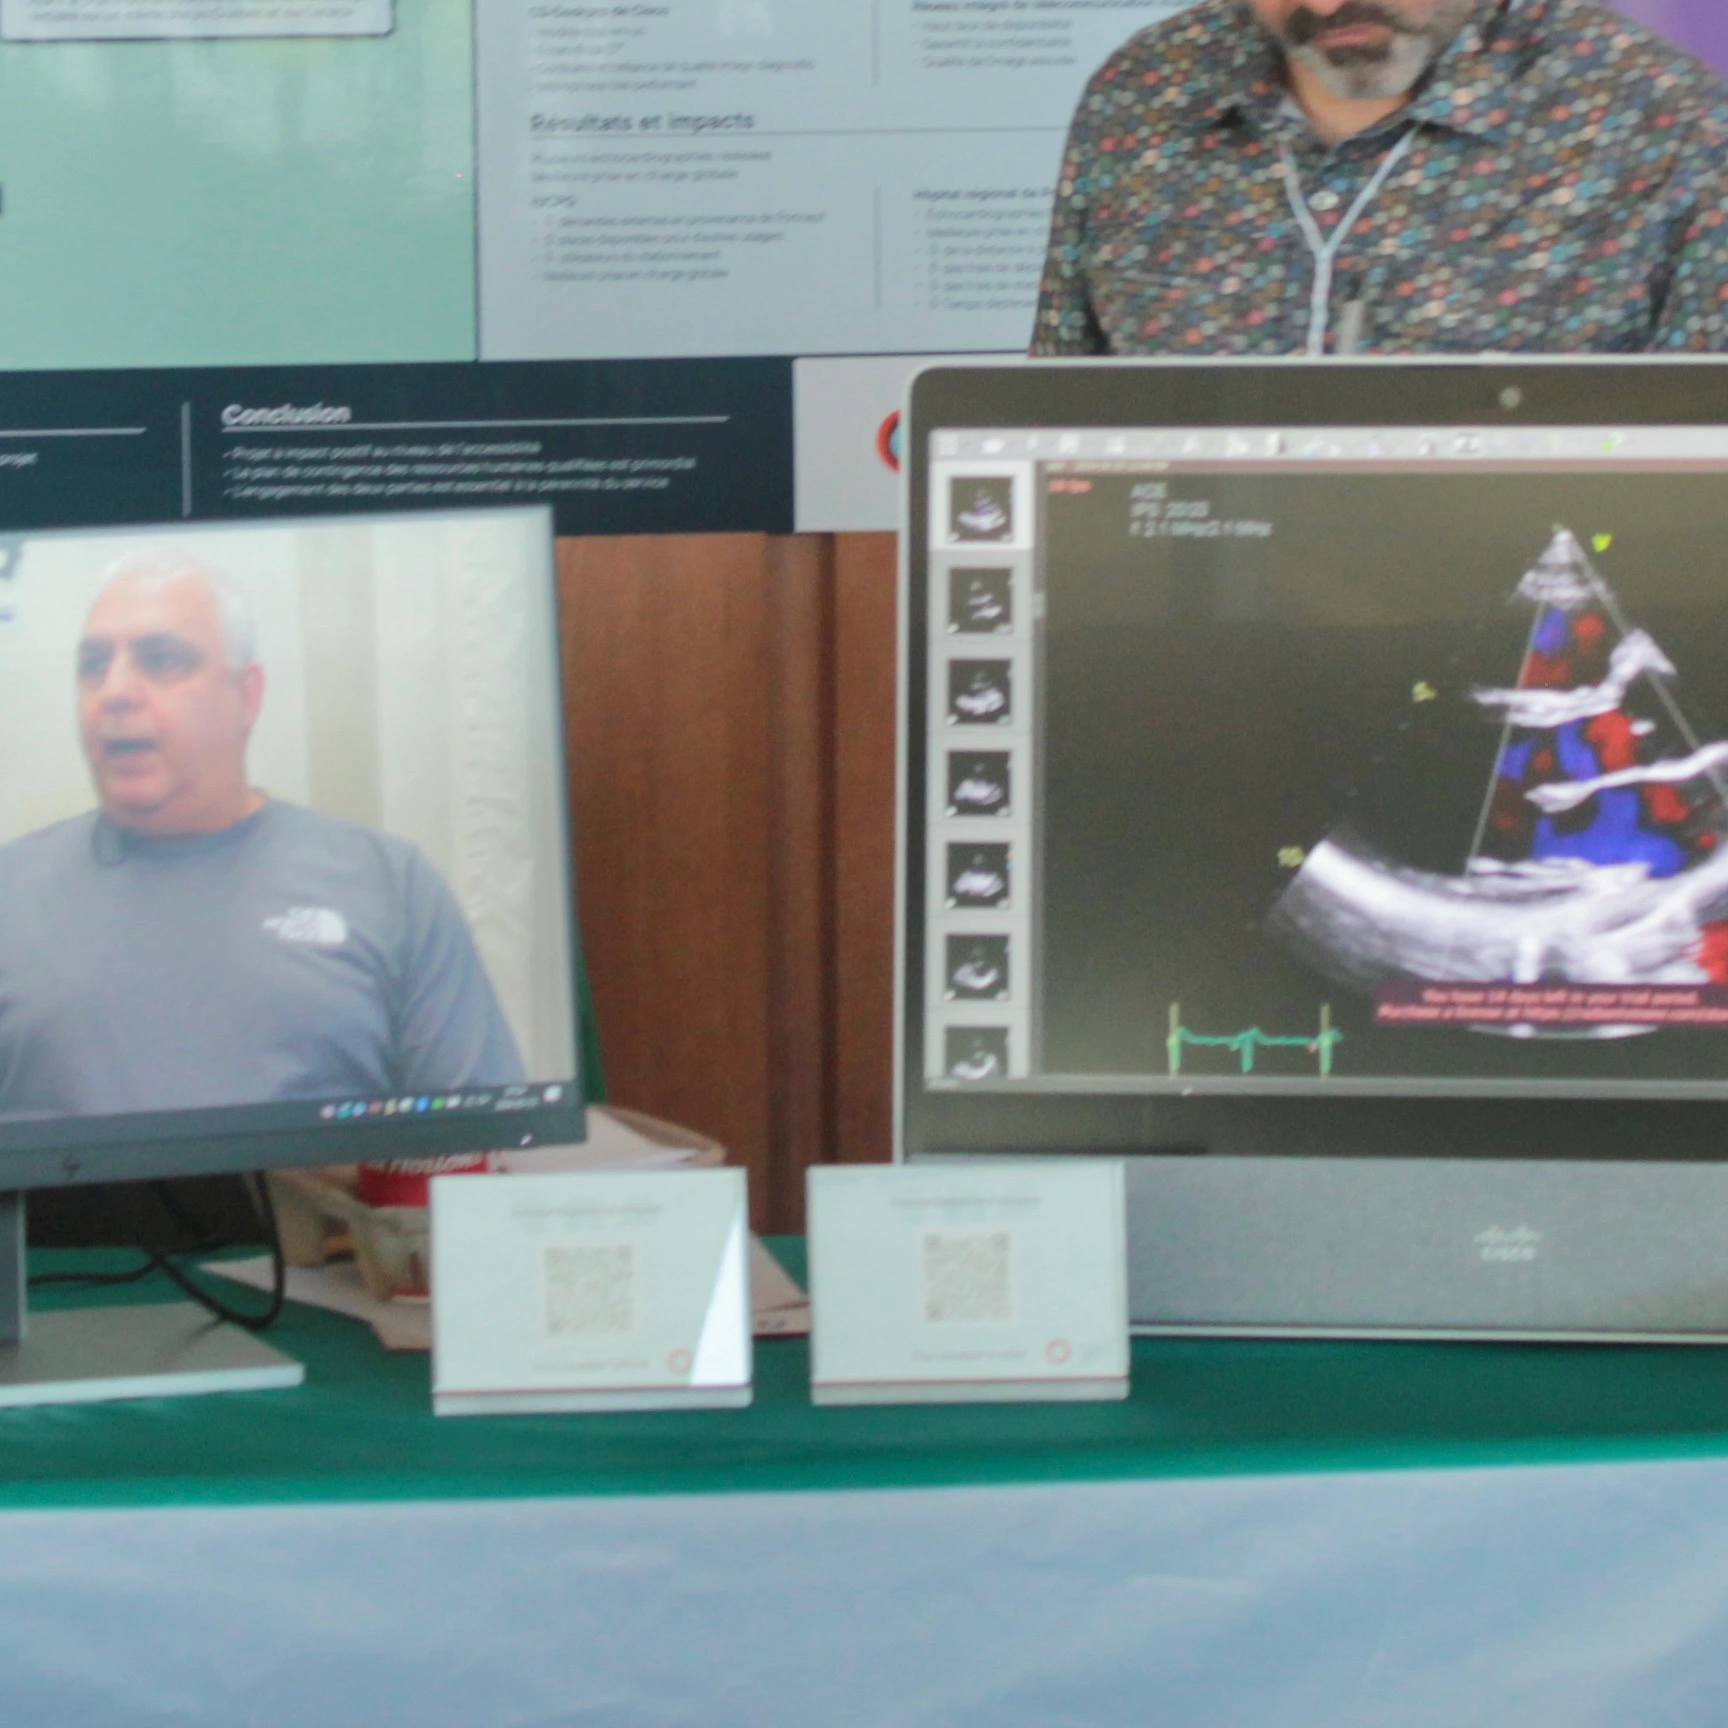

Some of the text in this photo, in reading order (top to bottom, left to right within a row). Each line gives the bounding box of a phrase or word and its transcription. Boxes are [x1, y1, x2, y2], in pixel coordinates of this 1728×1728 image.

[531, 112, 756, 134] Résultats et impacts
[221, 402, 352, 425] Conclusion
